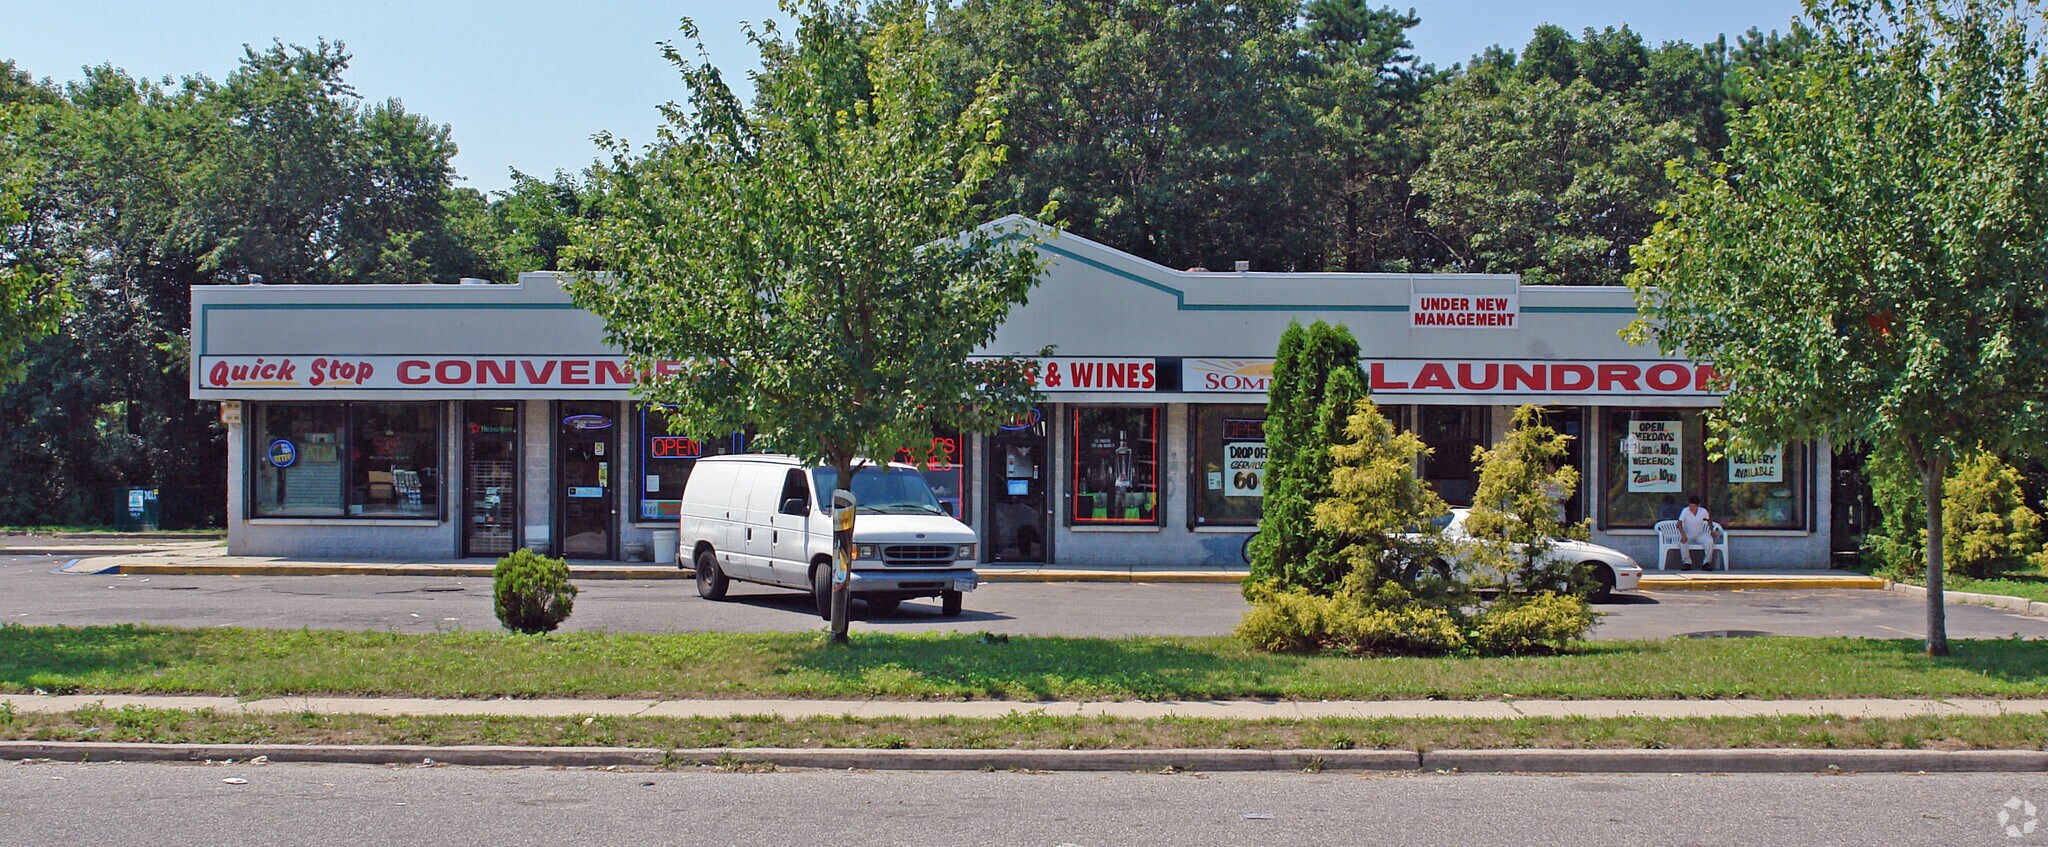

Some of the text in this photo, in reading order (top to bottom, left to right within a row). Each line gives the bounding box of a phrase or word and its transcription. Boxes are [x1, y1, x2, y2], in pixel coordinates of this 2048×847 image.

[1421, 298, 1508, 311] UNDER NEW
[1414, 313, 1515, 326] MANAGEMENT
[209, 358, 297, 387] Quick
[309, 357, 374, 386] Stop
[1045, 362, 1062, 388] &
[1070, 362, 1155, 388] WINES
[1639, 422, 1665, 432] OPEN
[653, 438, 699, 456] OPEN
[1229, 446, 1253, 459] DROP
[1632, 456, 1675, 466] WEEKENDS
[1734, 466, 1775, 479] AVAILABLE
